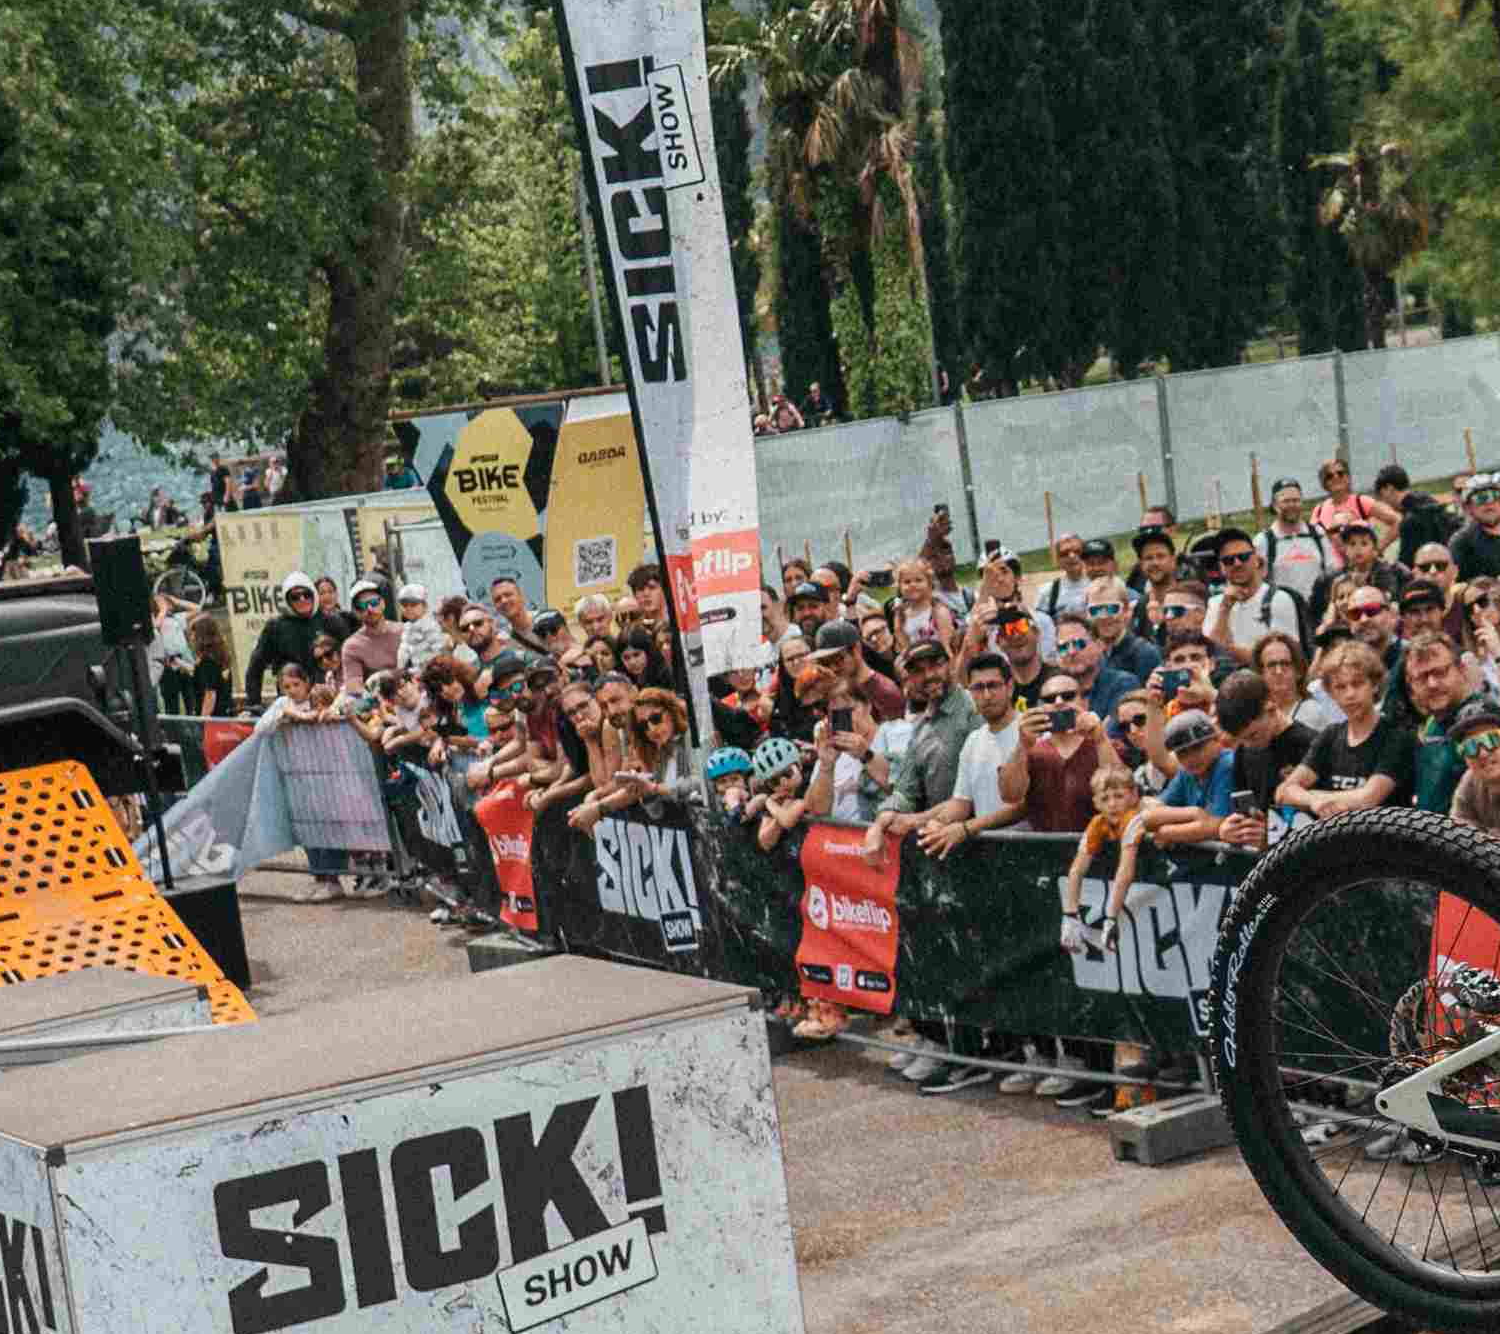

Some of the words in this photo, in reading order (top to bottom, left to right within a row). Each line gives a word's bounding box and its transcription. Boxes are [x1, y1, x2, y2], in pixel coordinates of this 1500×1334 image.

[654, 82, 688, 170] SHOW
[584, 55, 687, 383] SICK!
[453, 464, 520, 493] BIKE
[594, 818, 701, 931] SICK!
[665, 919, 692, 939] SHOW
[831, 893, 893, 934] bikeflip
[524, 1238, 634, 1308] SHOW
